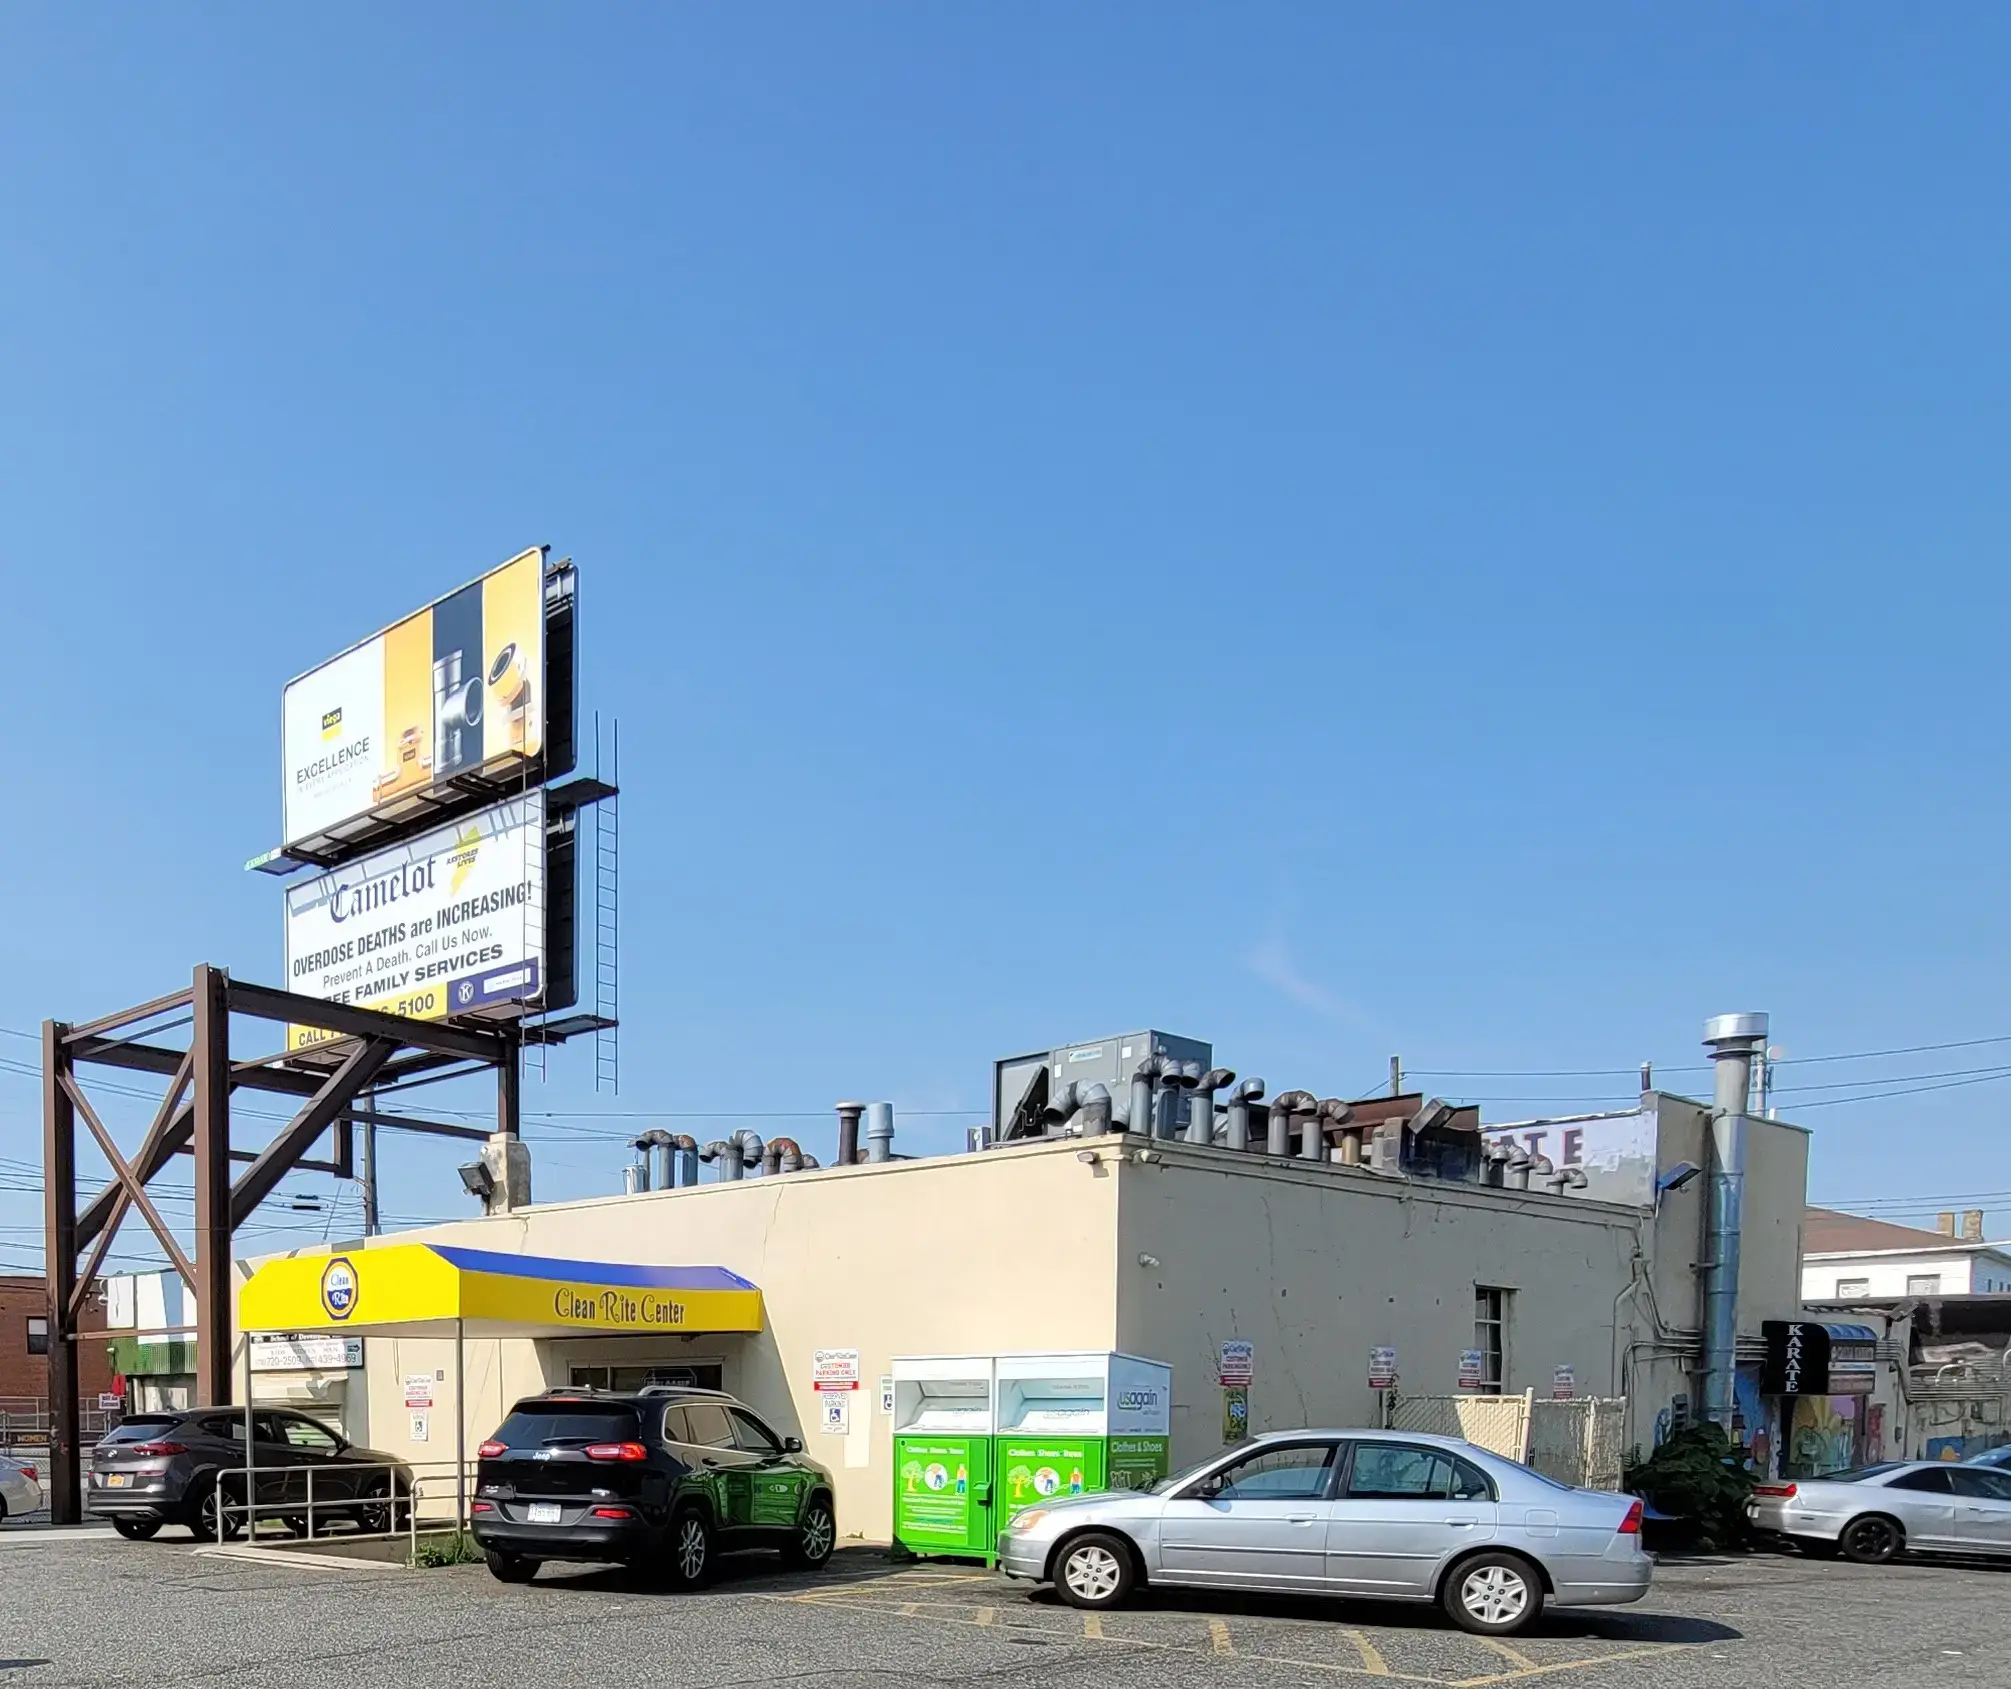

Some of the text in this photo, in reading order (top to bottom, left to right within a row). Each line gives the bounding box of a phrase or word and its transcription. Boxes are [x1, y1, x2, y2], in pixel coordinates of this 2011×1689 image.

[296, 736, 370, 785] EXCELLENCE
[331, 856, 437, 924] Camelot
[293, 880, 532, 978] OVERDOSE DEATHS are INCREASING!
[323, 962, 363, 990] Prevent
[365, 959, 374, 975] A
[415, 938, 438, 959] Call
[442, 925, 458, 951] Us
[461, 926, 493, 946] Now.
[355, 971, 410, 1000] FAMILY
[414, 943, 504, 982] SERVICES
[298, 1027, 327, 1047] CALL
[330, 1273, 350, 1287] Clean
[553, 1287, 685, 1325] Clean Rite Center
[1784, 1324, 1805, 1393] KARATE
[1117, 1389, 1158, 1411] usagain
[533, 1452, 551, 1461] Jeep
[1111, 1441, 1136, 1453] Clothes
[1143, 1441, 1163, 1453] Shoes
